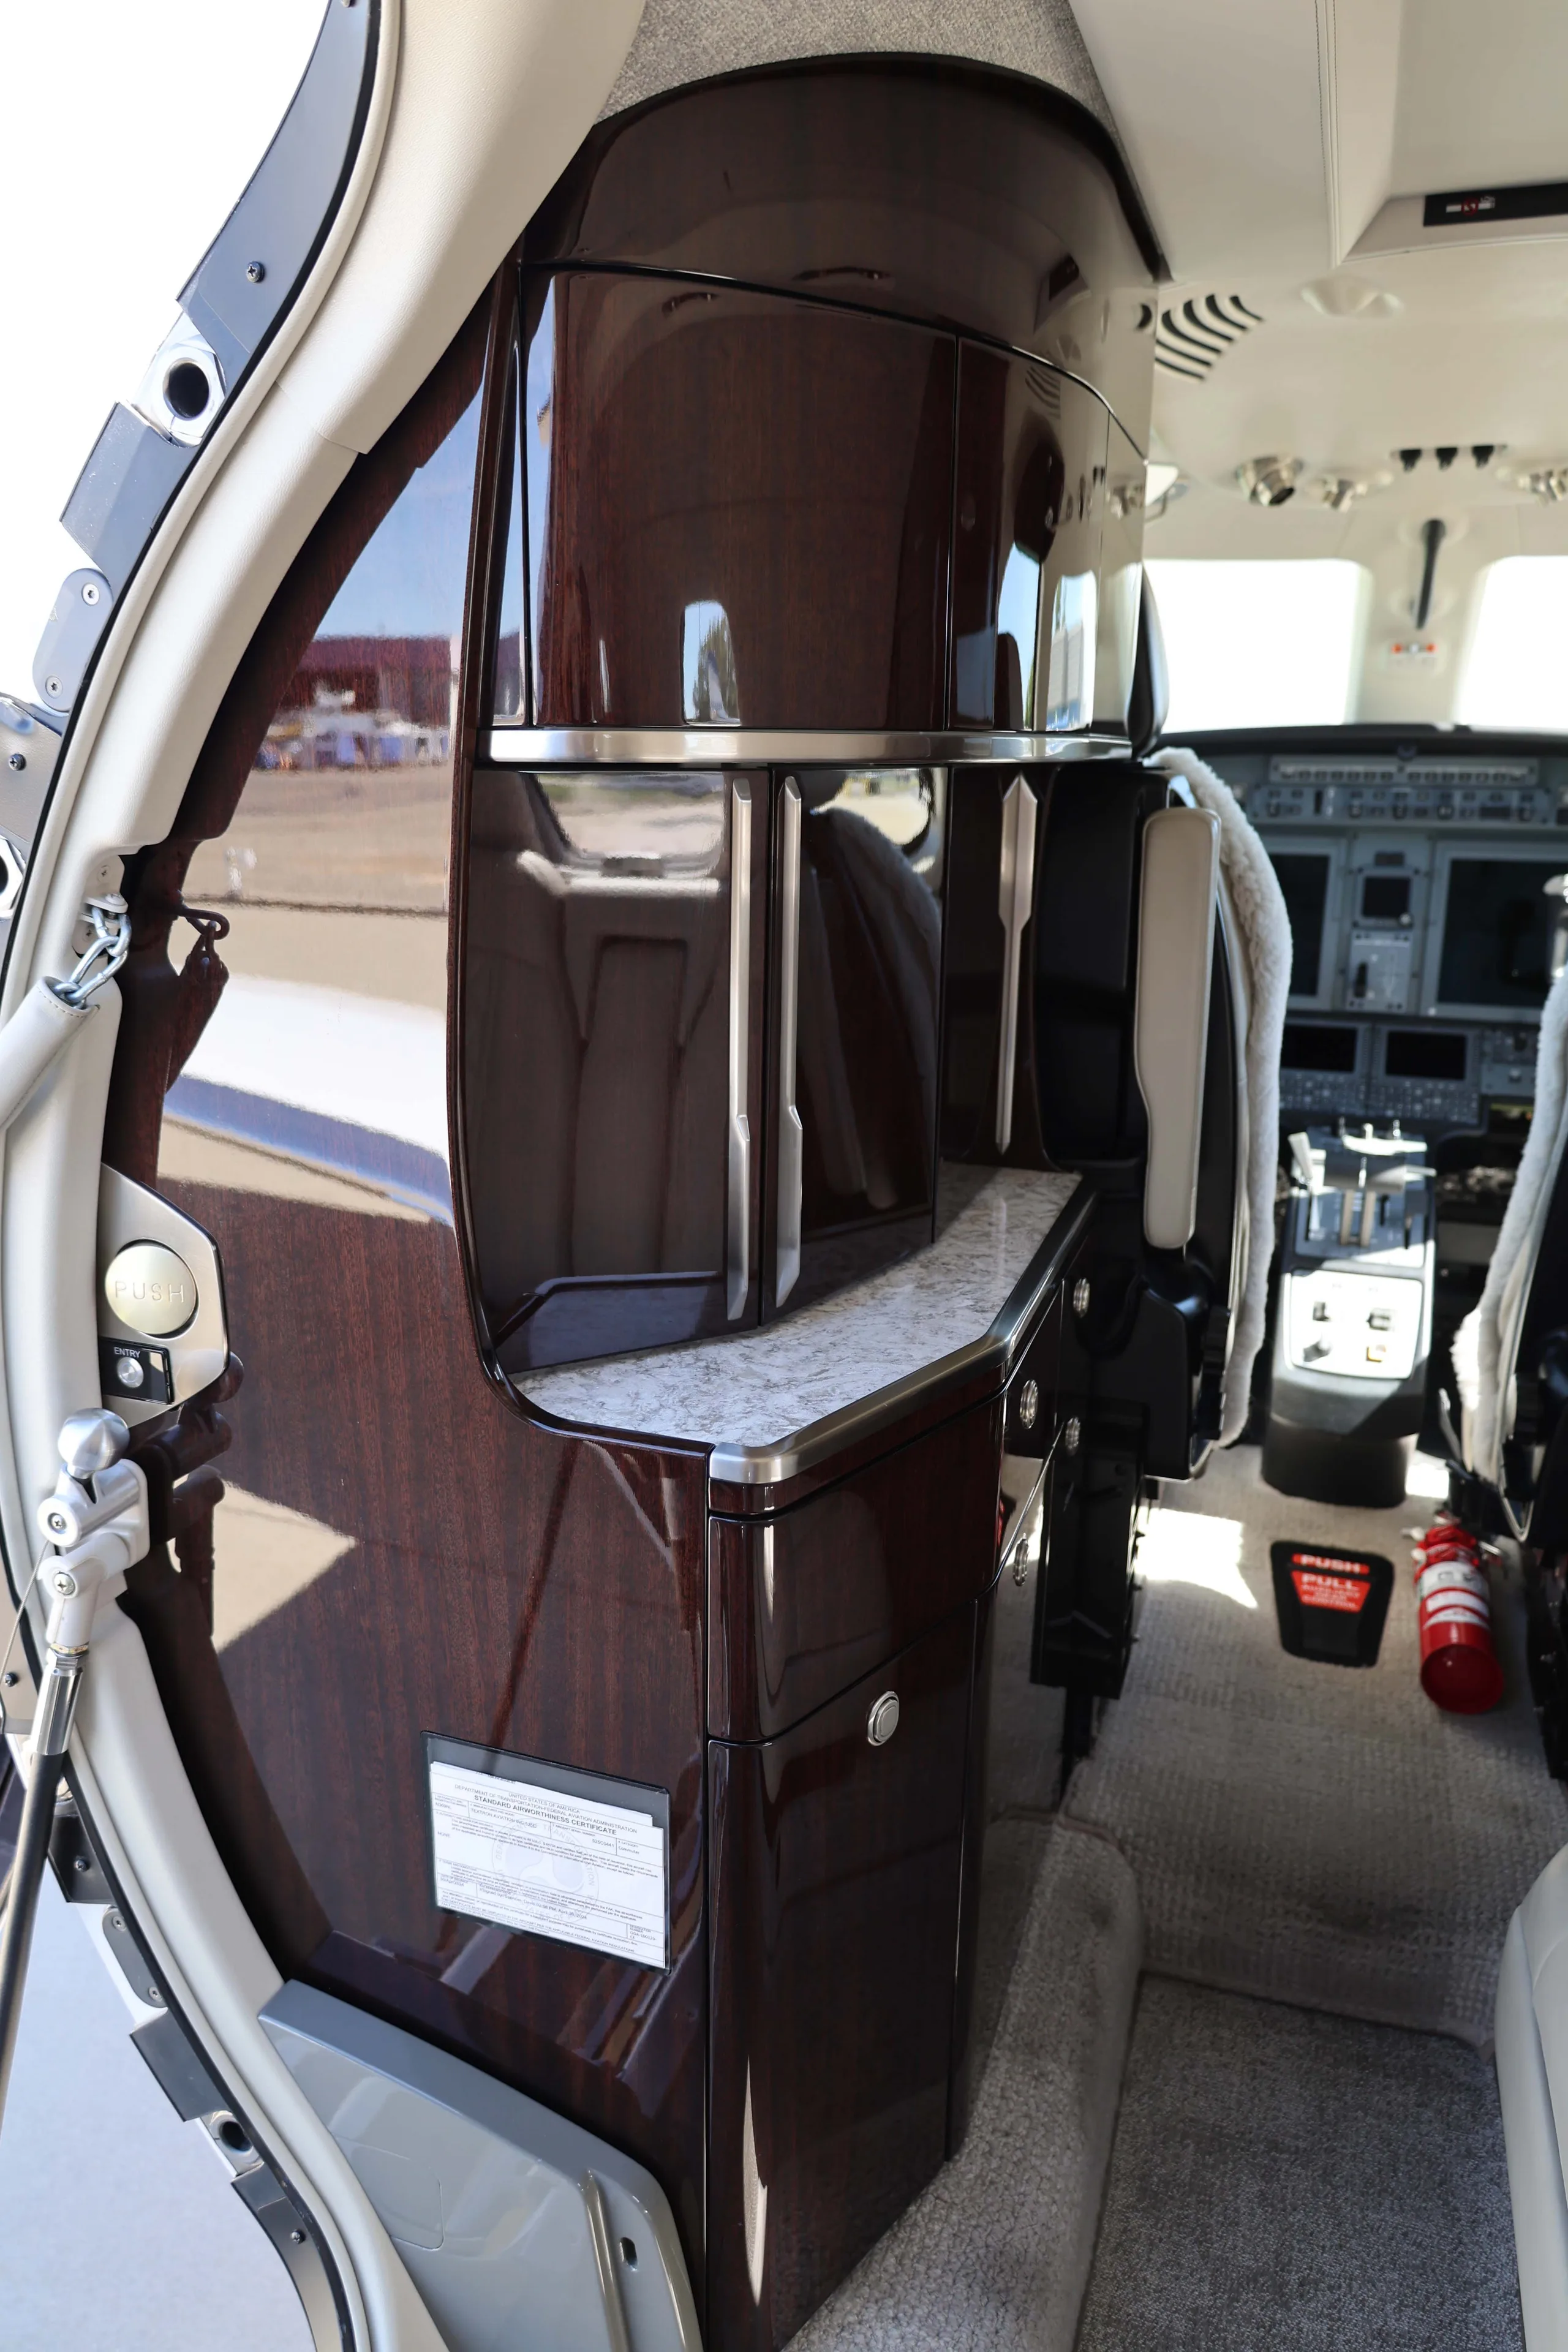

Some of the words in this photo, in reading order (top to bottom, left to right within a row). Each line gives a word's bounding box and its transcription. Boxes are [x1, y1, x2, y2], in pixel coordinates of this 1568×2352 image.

[115, 1280, 184, 1303] PUSH
[114, 1347, 140, 1358] ENTRY
[1301, 1554, 1360, 1574] PUSH
[1302, 1574, 1354, 1589] PULL
[455, 1784, 487, 1796] DEPARTMENT
[568, 1812, 592, 1822] AVIATION
[593, 1818, 636, 1833] ADMINISTRATION
[528, 1797, 547, 1806] STATES
[556, 1804, 579, 1814] AMERICA
[470, 1807, 492, 1817] TEXTRON
[493, 1814, 514, 1823] AVIATION
[474, 1795, 511, 1809] STANDARD
[513, 1804, 569, 1823] AIRWORTHINESS
[571, 1819, 616, 1835] CERTIFICATE
[592, 1838, 614, 1848] 525C0441
[618, 1845, 639, 1854] Commuter
